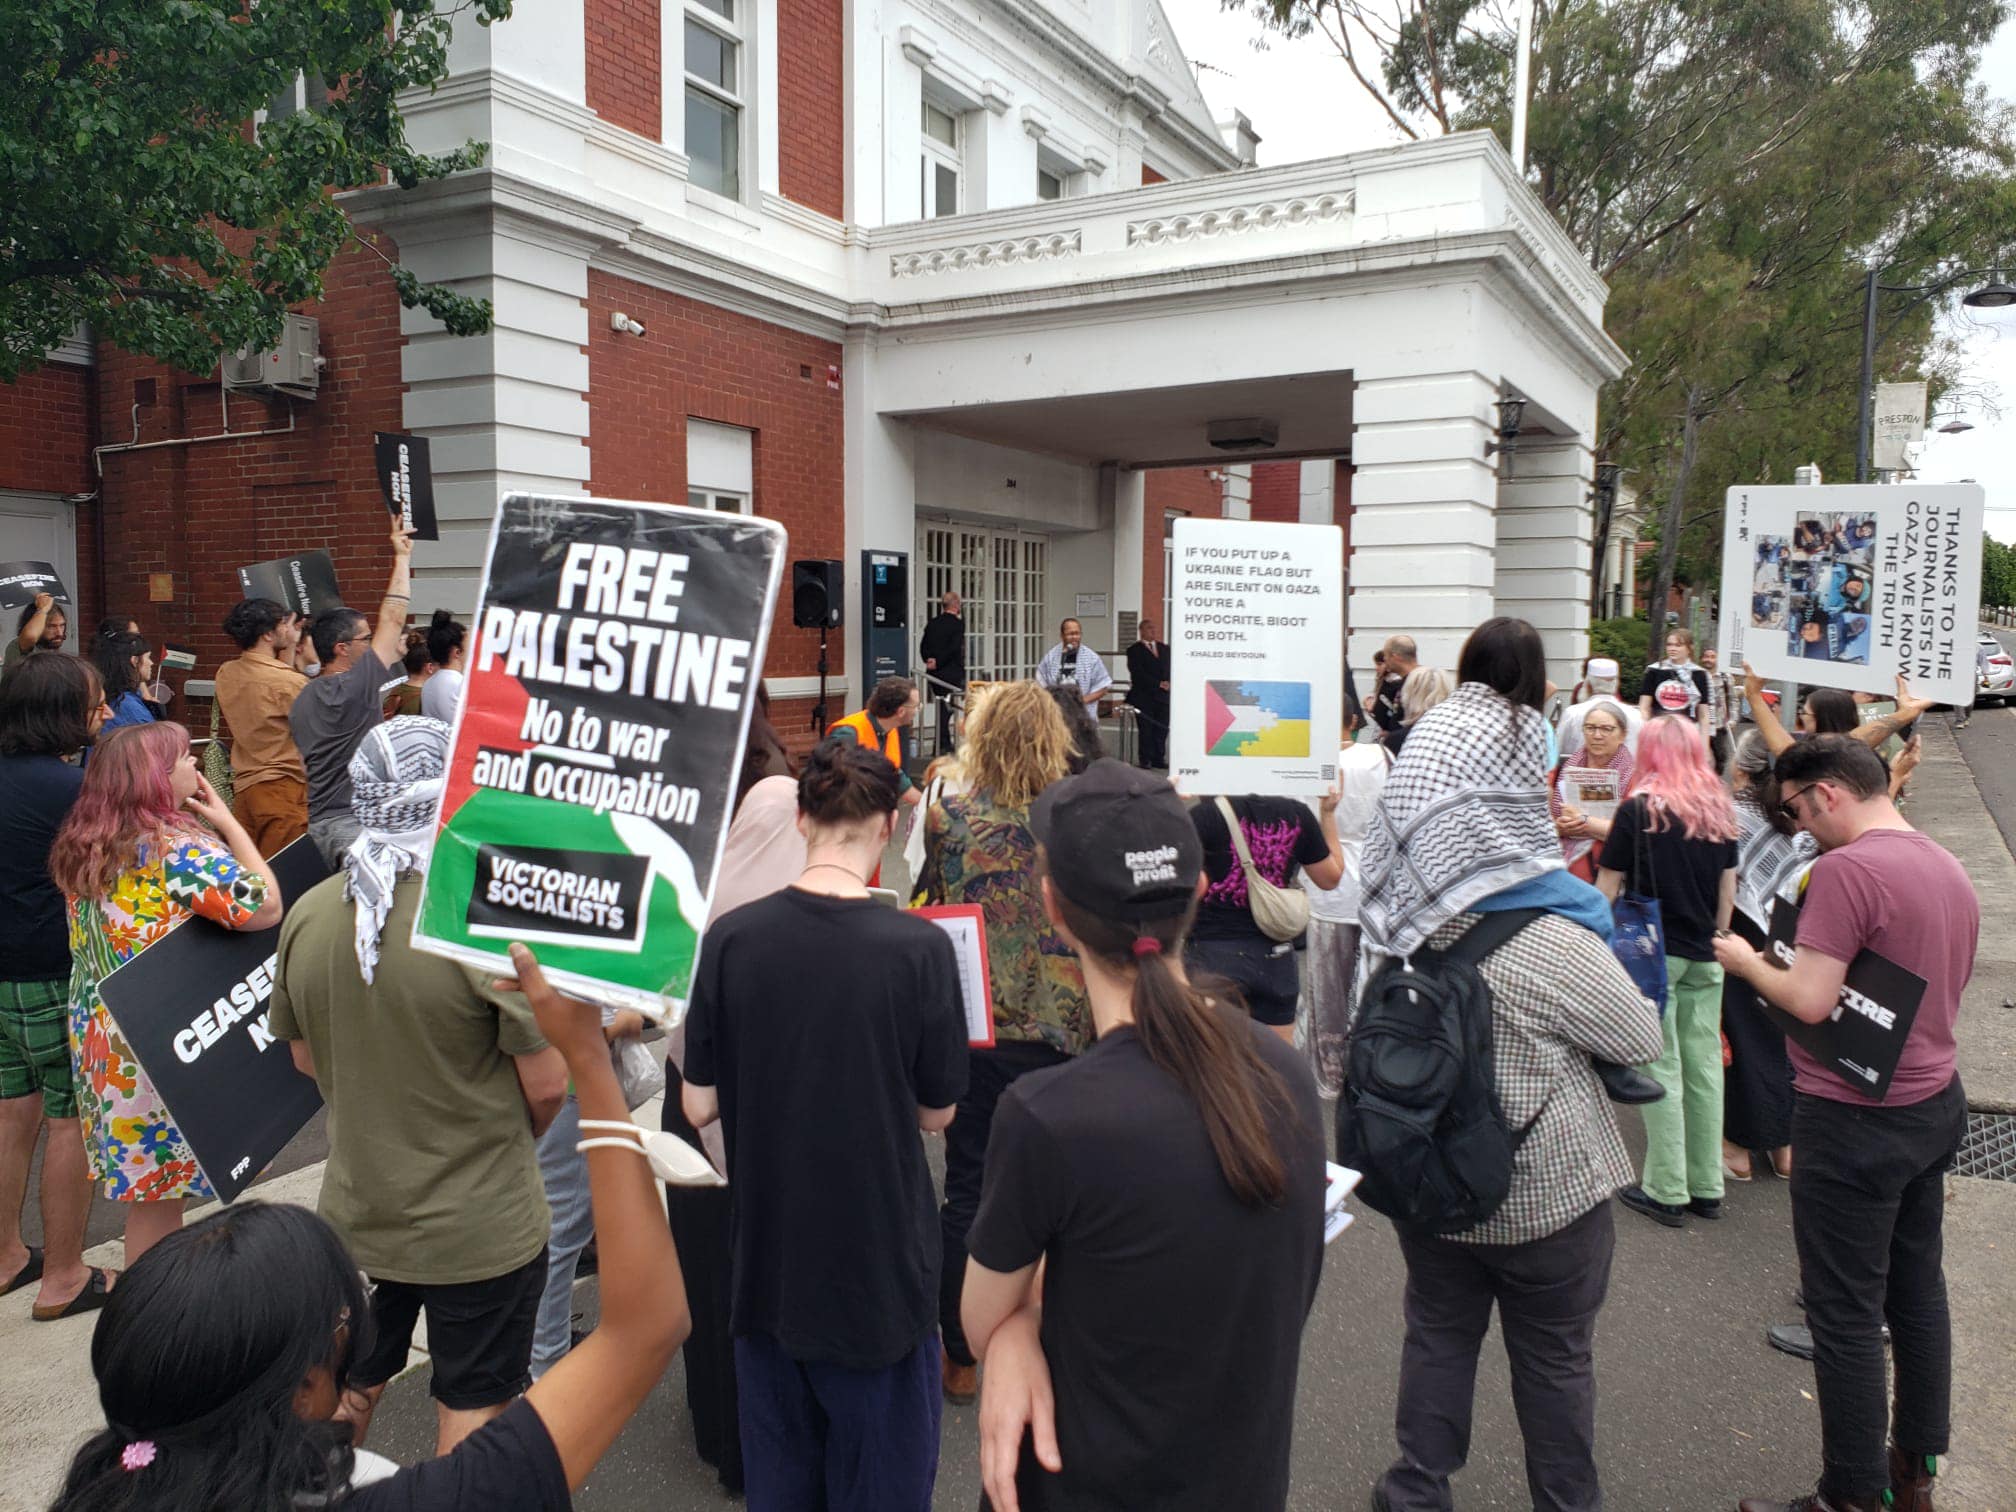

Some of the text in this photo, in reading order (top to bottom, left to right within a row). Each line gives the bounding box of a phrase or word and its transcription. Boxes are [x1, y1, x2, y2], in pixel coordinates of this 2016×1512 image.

[1879, 414, 1921, 425] PRESTON
[391, 471, 401, 502] NOW
[399, 444, 413, 530] CEASEFIRE
[1185, 547, 1292, 561] IF YOU PUT UP A
[1185, 564, 1313, 578] UKRAINE FLAG BUT
[290, 560, 309, 598] Ceasefire
[557, 542, 690, 623] FREE
[1184, 580, 1321, 595] ARE SILENT ON GAZA
[1880, 532, 1899, 648] THE TRUTH
[1898, 501, 1920, 682] GAZA, WE KNOW
[1918, 505, 1940, 679] JOURNALISTS IN
[1937, 507, 1960, 680] THANKS TO THE
[1184, 597, 1246, 609] YOU'RE A
[1184, 613, 1308, 627] HYPOCRITE, BIGOT
[1184, 630, 1248, 641] OR BOTH.
[477, 605, 752, 712] PALESTINE
[519, 697, 671, 763] No to war
[471, 750, 701, 826] and occupation
[1125, 845, 1178, 867] people
[1133, 863, 1177, 886] profit
[490, 855, 622, 906] VICTORIAN
[486, 879, 625, 931] SOCIALISTS
[173, 951, 279, 1063] CEASEF
[230, 1156, 250, 1181] FPP
